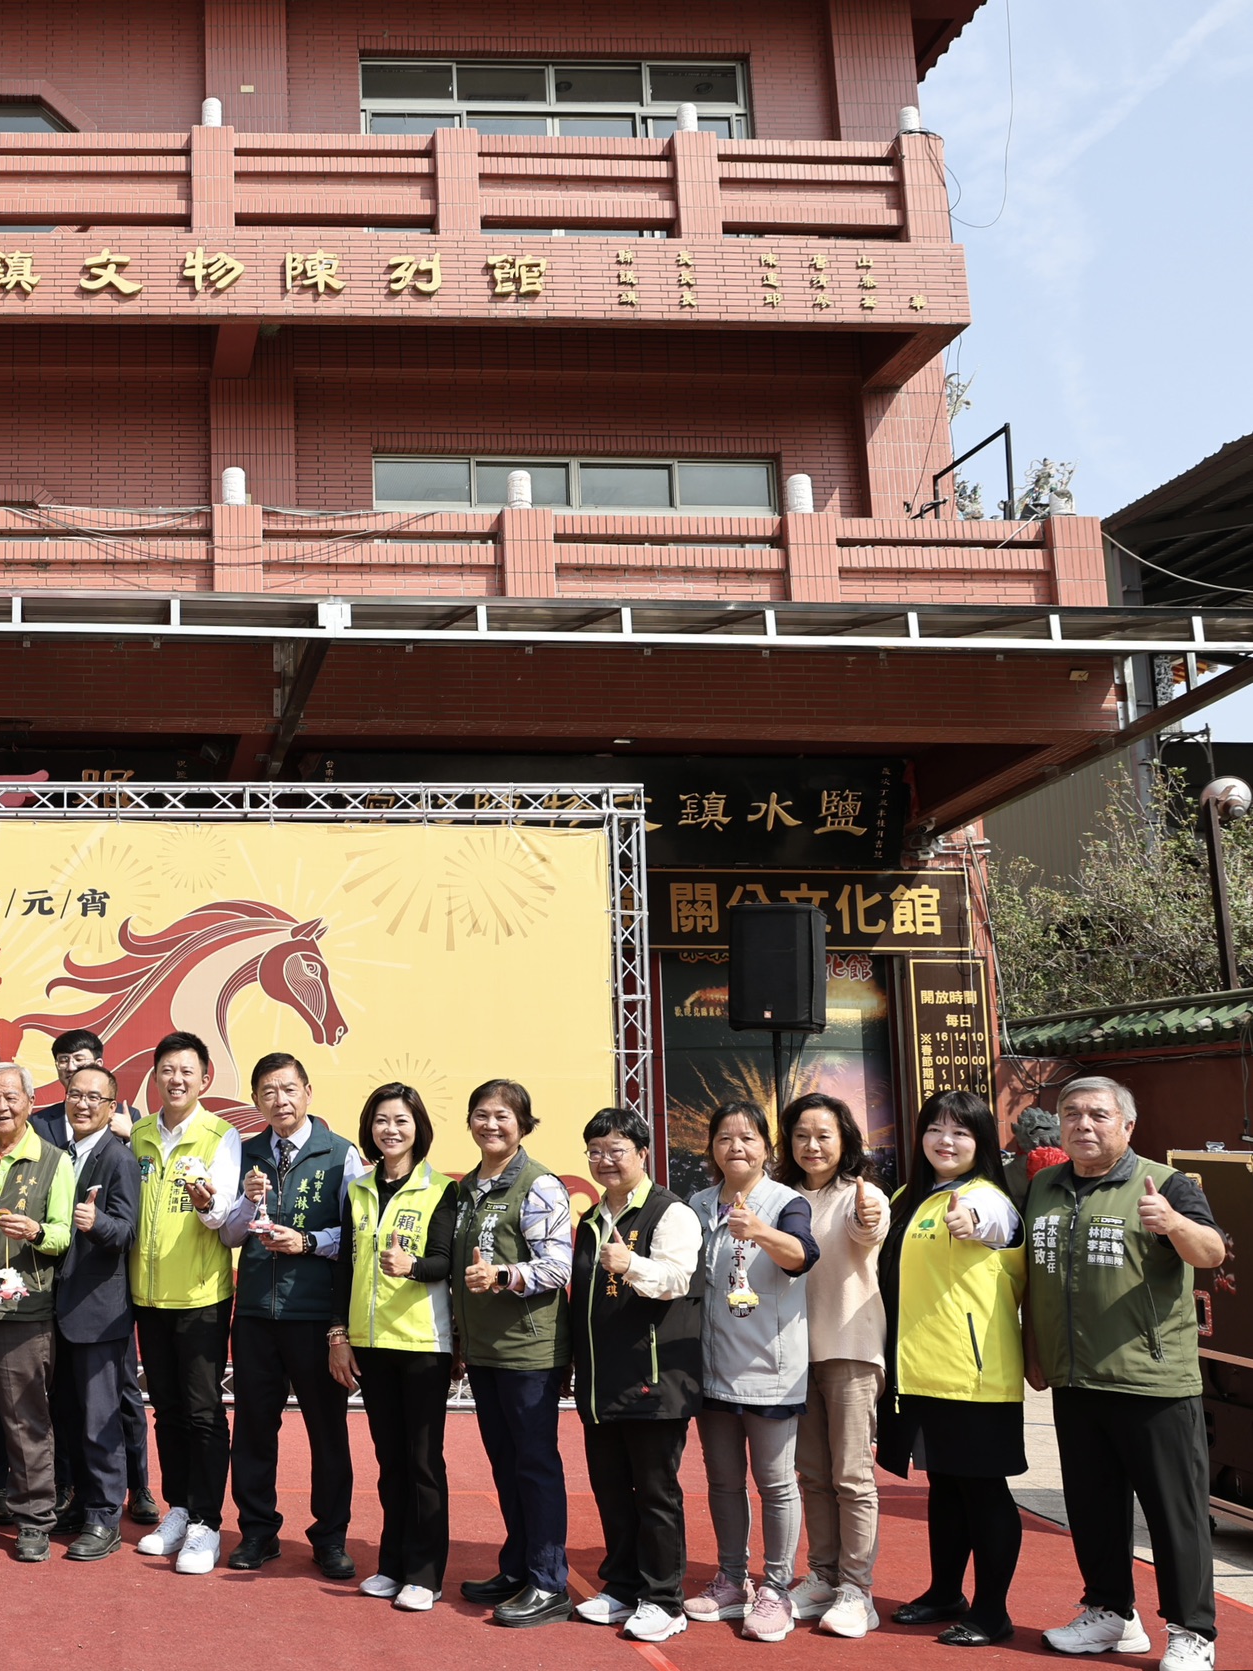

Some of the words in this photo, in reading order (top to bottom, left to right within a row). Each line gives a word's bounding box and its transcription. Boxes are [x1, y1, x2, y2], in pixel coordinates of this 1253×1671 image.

[920, 990, 978, 1005] 開放時間
[945, 1014, 972, 1028] 每日
[312, 1169, 325, 1203] 副市長
[292, 1178, 311, 1229] 姜淋煌
[1100, 1217, 1124, 1225] DPP
[1032, 1216, 1047, 1265] 高宏政
[1088, 1226, 1124, 1241] 林俊憲
[1087, 1240, 1125, 1255] 李宗翰
[1087, 1254, 1124, 1266] 服務團隊
